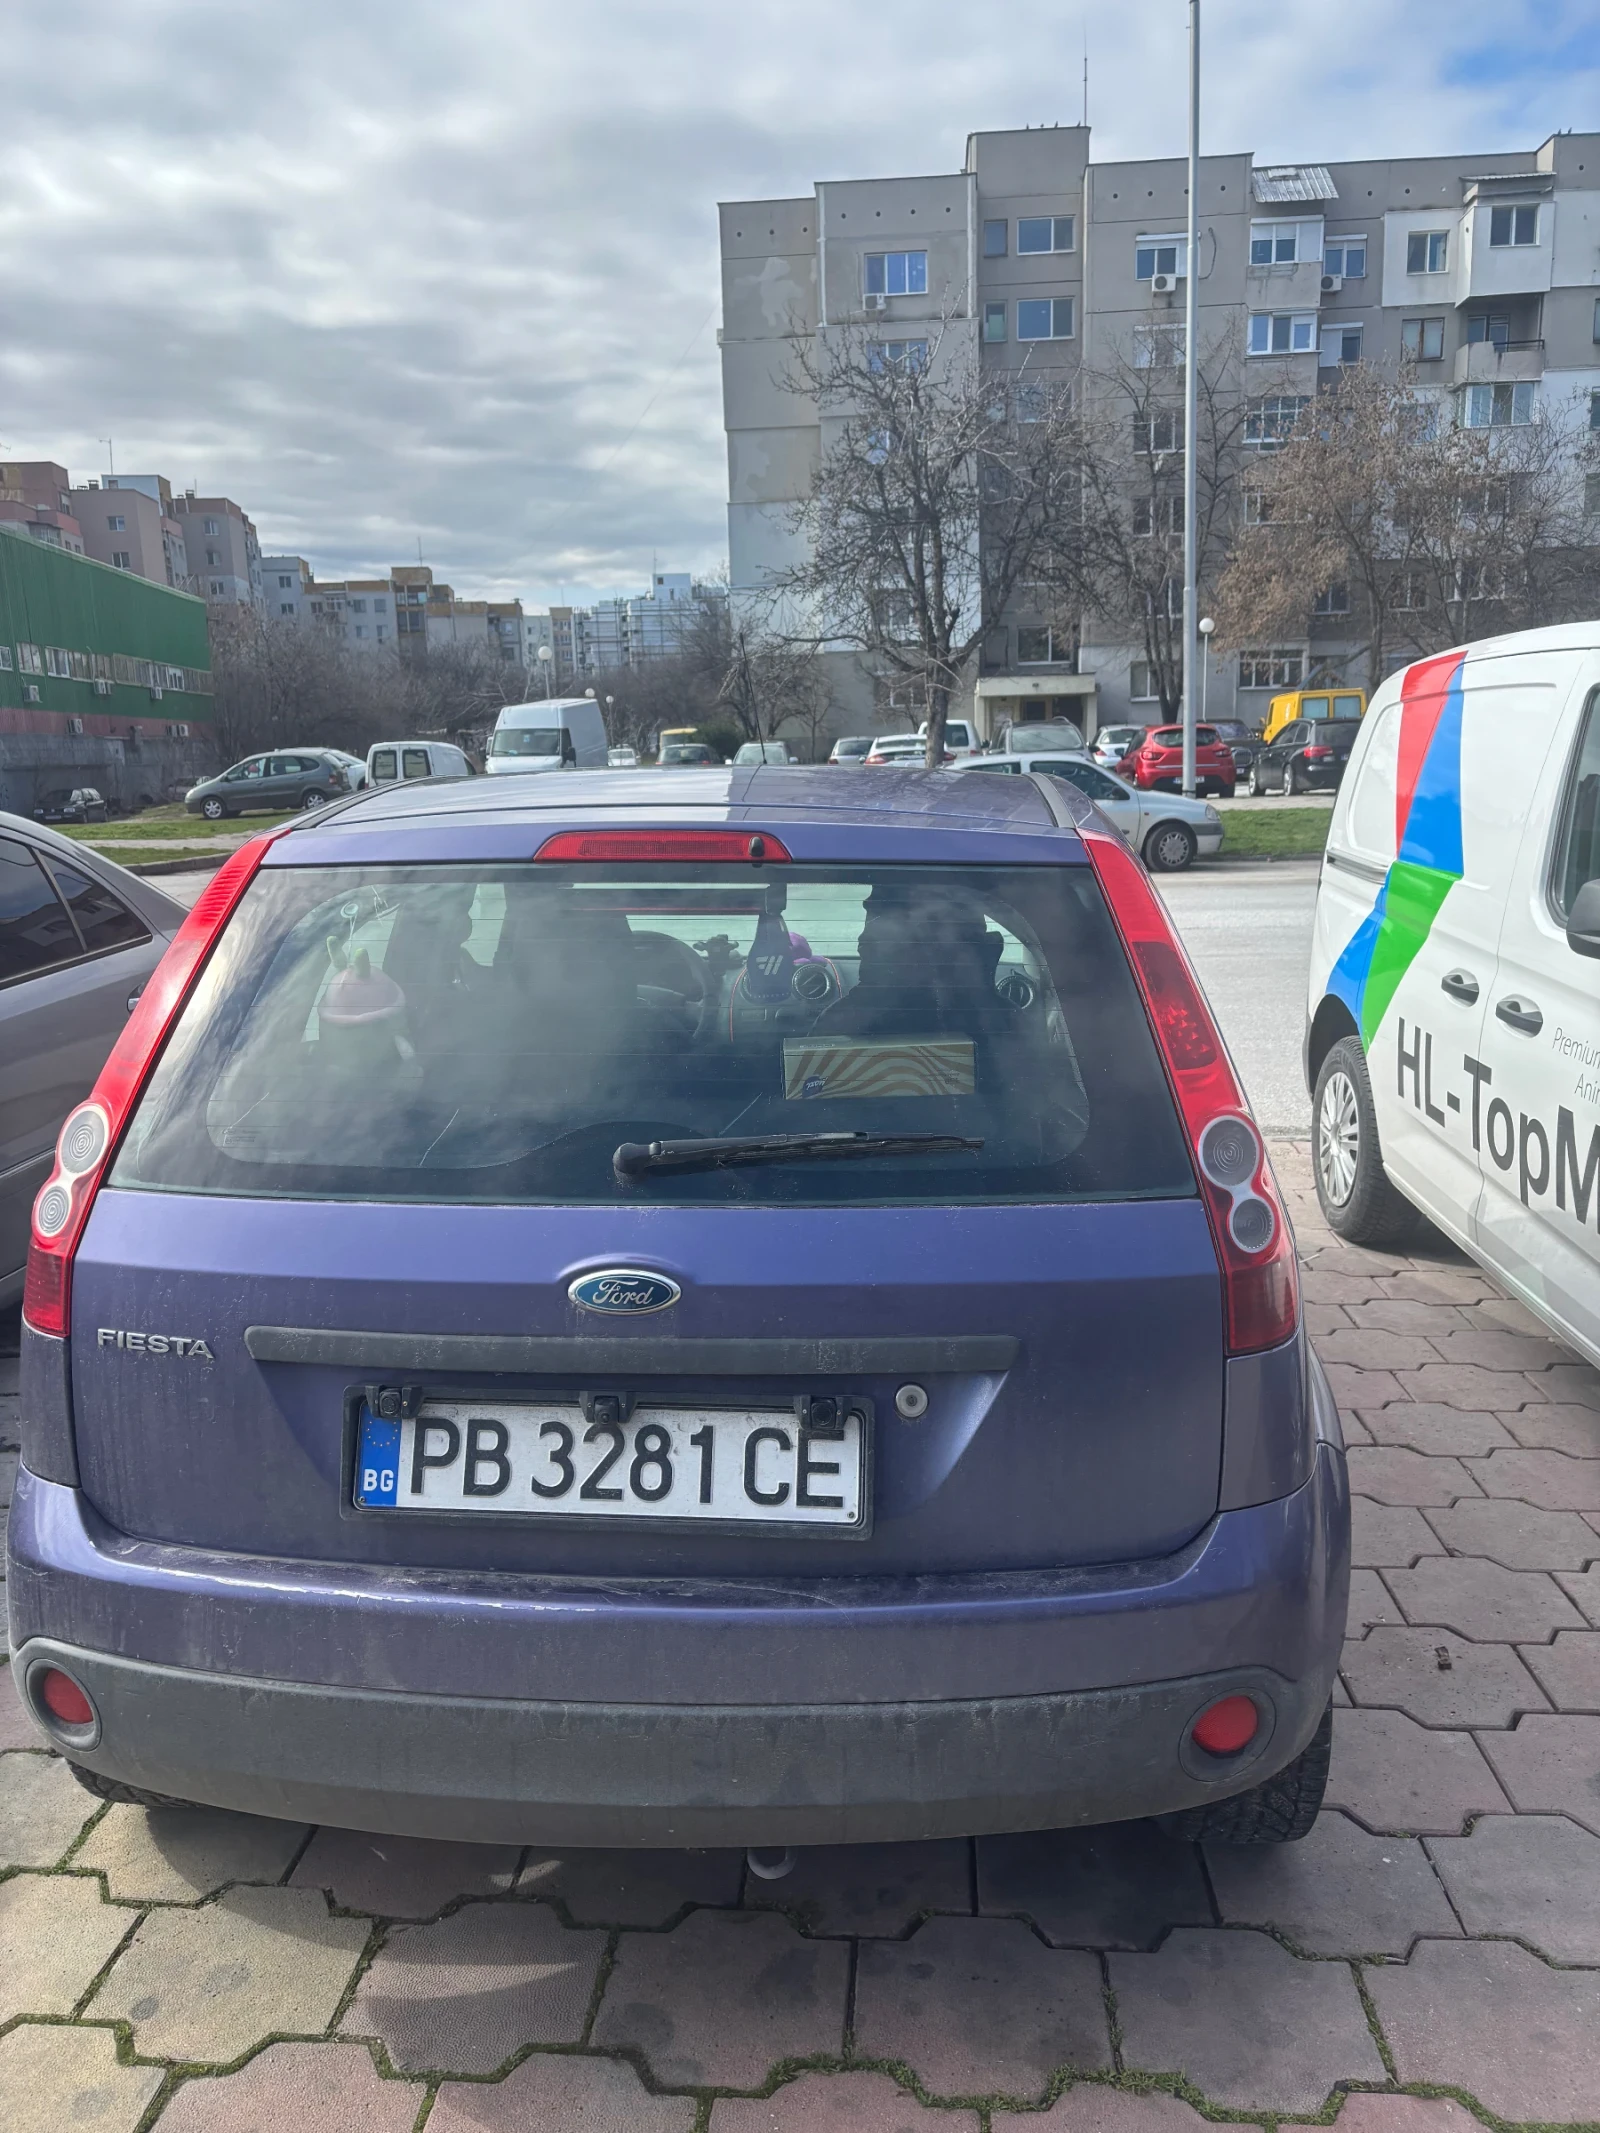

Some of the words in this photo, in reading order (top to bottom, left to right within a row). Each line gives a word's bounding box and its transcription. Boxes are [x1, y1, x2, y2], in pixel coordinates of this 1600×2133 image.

[592, 1279, 655, 1305] Ford
[97, 1328, 215, 1359] FIESTA
[363, 1458, 394, 1492] BG
[411, 1417, 512, 1496] PB
[531, 1420, 714, 1504] 3281
[744, 1426, 845, 1508] CE
